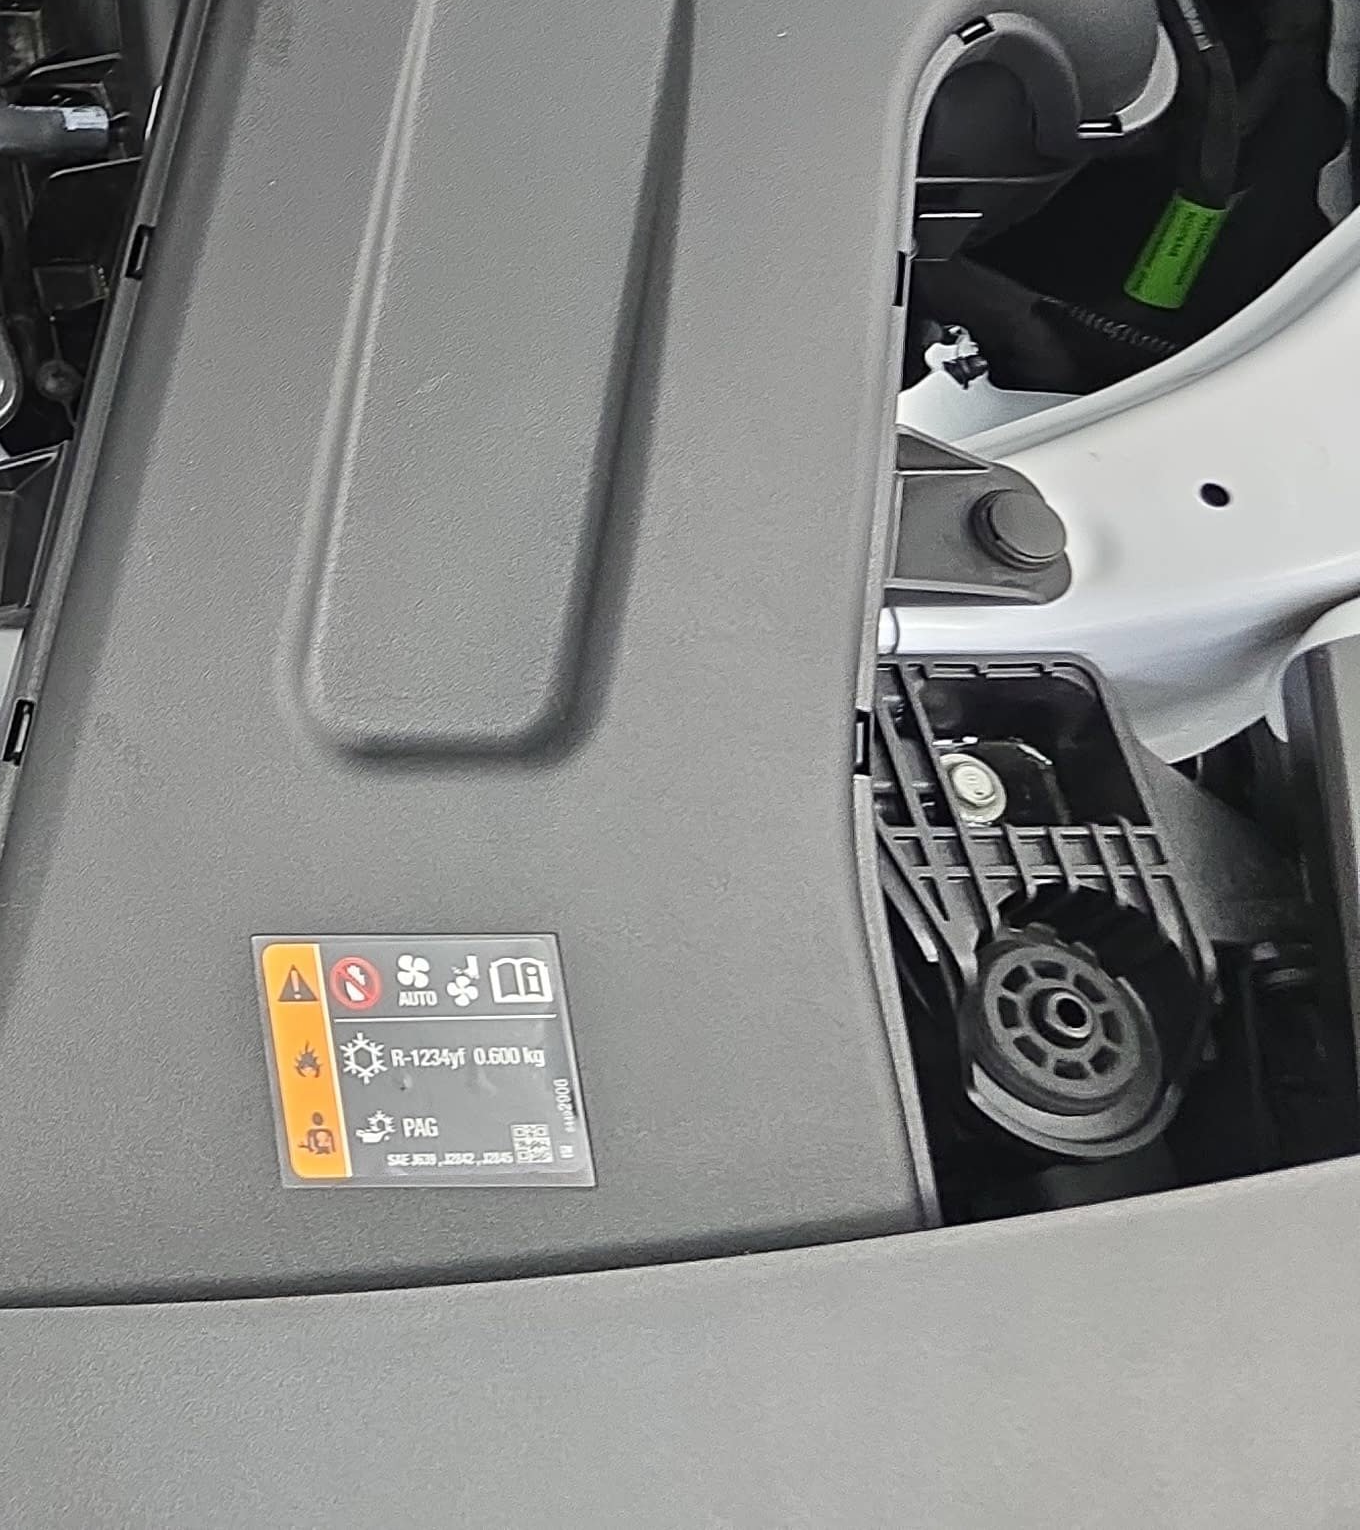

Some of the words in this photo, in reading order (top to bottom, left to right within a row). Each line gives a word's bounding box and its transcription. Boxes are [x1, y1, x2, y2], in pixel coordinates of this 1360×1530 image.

[398, 991, 438, 1007] AUTO
[391, 1047, 467, 1070] R-1234yf
[473, 1046, 520, 1066] 0.600
[523, 1046, 546, 1068] kg
[402, 1118, 440, 1138] PAG
[386, 1153, 411, 1166] SAE
